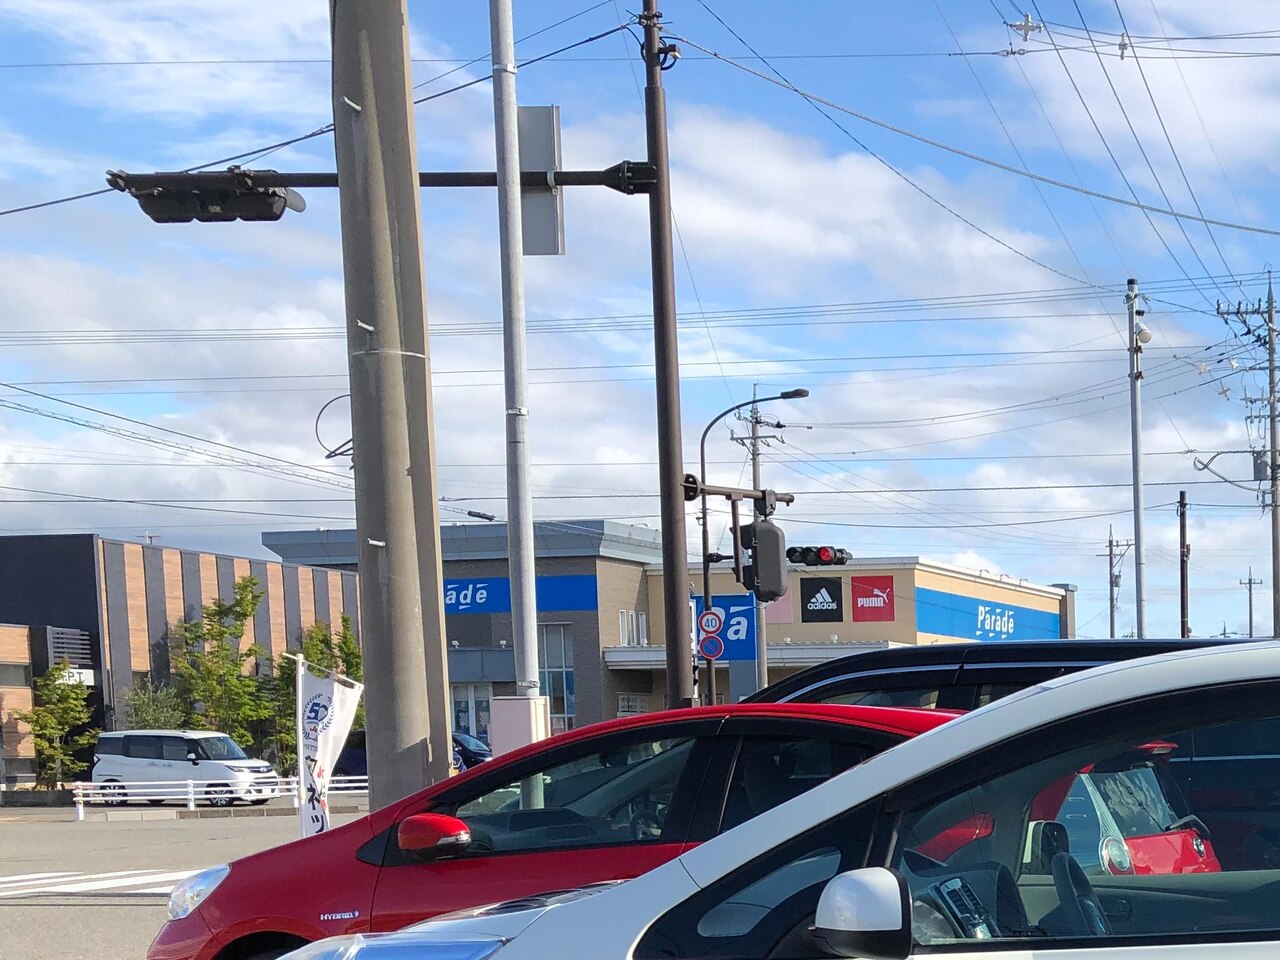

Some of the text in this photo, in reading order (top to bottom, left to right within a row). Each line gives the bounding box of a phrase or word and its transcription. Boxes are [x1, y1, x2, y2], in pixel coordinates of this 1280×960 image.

[445, 583, 488, 605] ade
[807, 601, 837, 610] adidas
[858, 597, 884, 608] PUMA
[704, 618, 717, 629] 40
[977, 605, 1015, 634] Parade
[320, 911, 354, 921] HYBRID
